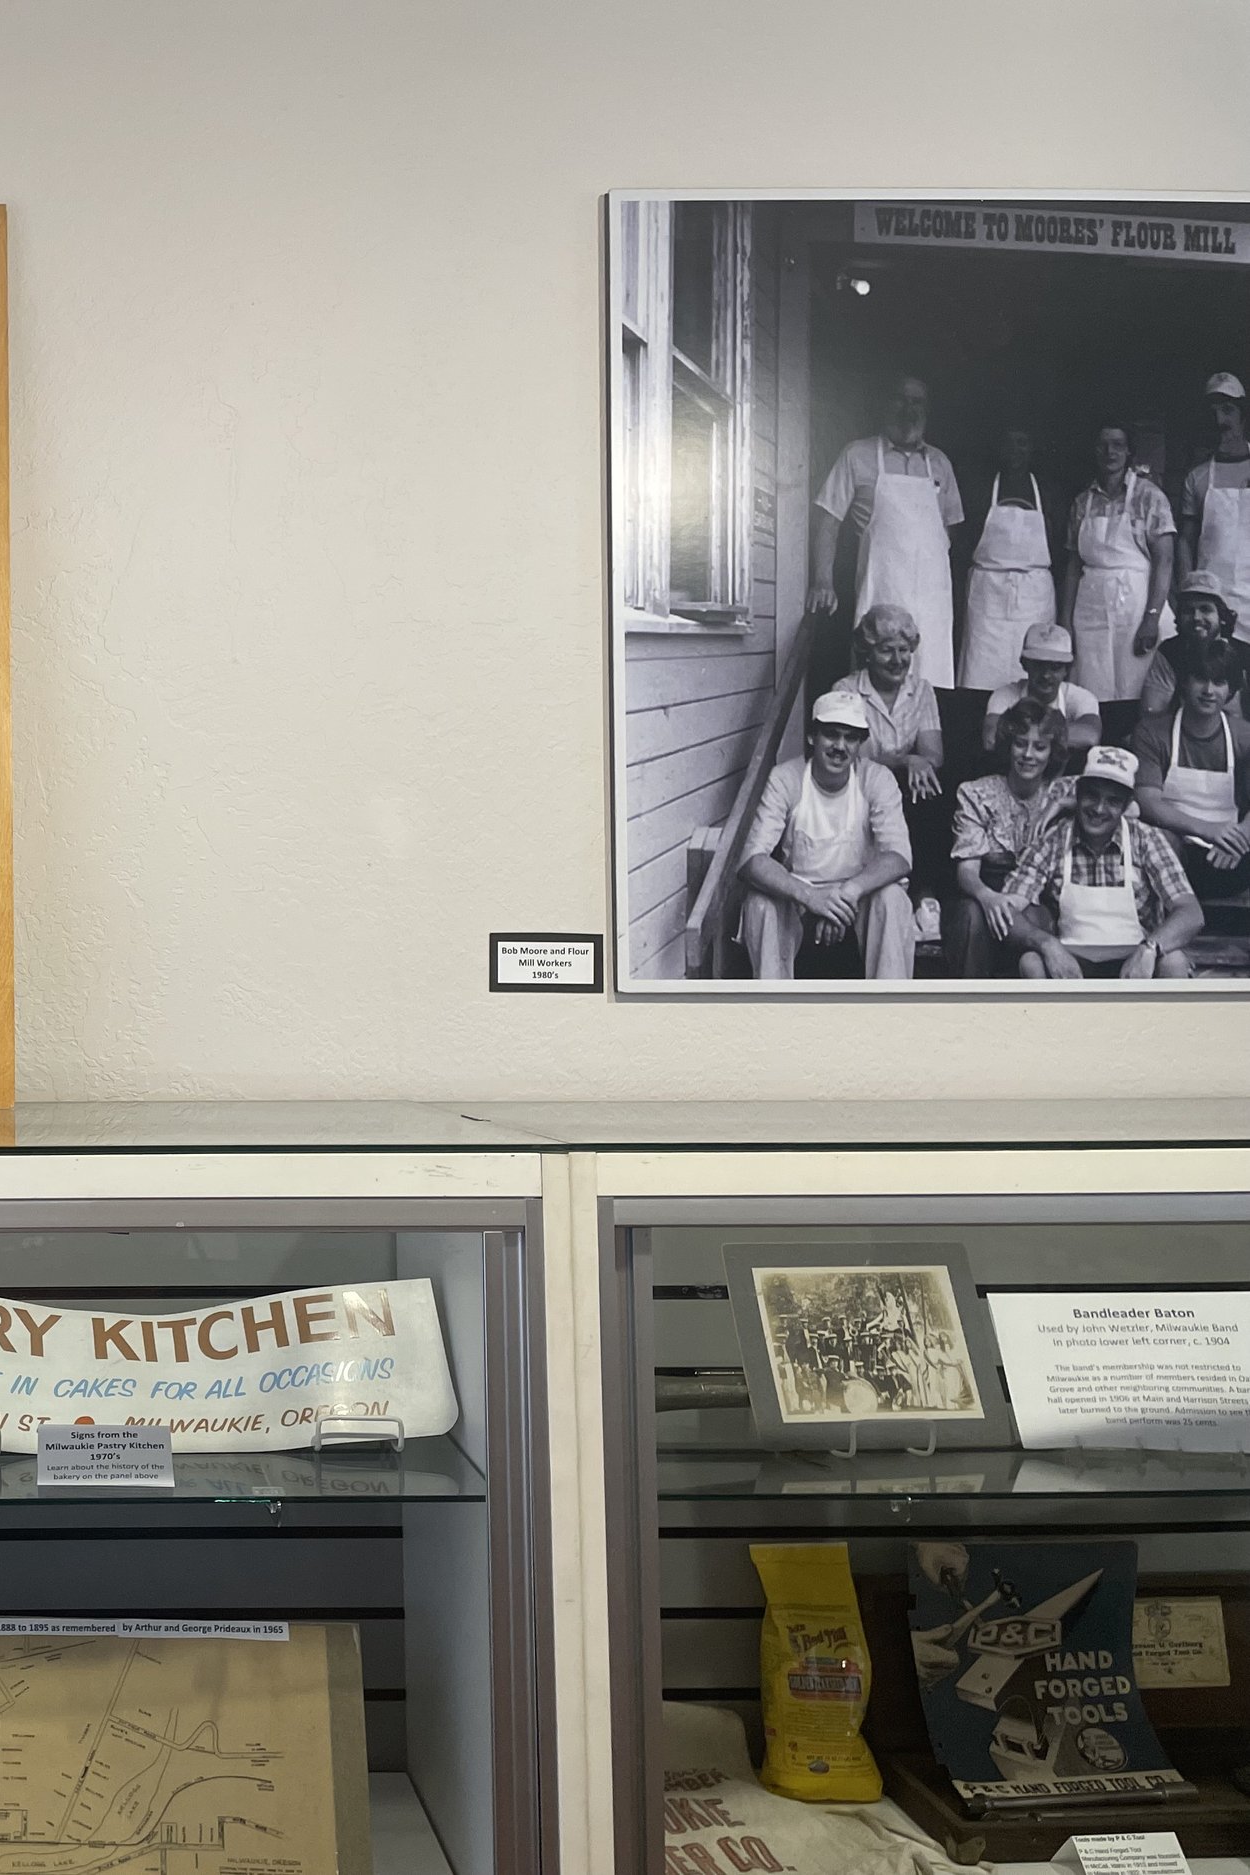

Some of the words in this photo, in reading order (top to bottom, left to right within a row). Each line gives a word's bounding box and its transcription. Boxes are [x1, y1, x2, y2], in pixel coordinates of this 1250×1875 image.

[875, 207, 976, 239] WELCOME
[982, 212, 1008, 241] TO
[1014, 214, 1104, 246] MOORES’
[1111, 219, 1176, 250] FLOUR
[1184, 224, 1236, 254] MILL
[501, 946, 518, 954] Bob
[520, 947, 548, 955] Moore
[549, 947, 565, 955] and
[567, 947, 589, 955] Flour
[518, 958, 534, 966] Mill
[536, 959, 572, 967] Workers
[1072, 1307, 1149, 1318] Bandleader
[1154, 1308, 1194, 1318] Baton
[91, 1288, 396, 1363] KITCHEN
[1037, 1324, 1064, 1333] Used
[1065, 1324, 1079, 1335] by
[1082, 1323, 1106, 1333] John
[1107, 1323, 1153, 1333] Wetzler,
[1155, 1322, 1209, 1332] Milwaukie
[1211, 1323, 1238, 1332] Band
[10, 1374, 39, 1396] IN
[53, 1377, 137, 1399] CAKES
[150, 1380, 198, 1401] FOR
[205, 1376, 247, 1399] ALL
[259, 1357, 395, 1393] OCCASIONS
[70, 1431, 95, 1440] Signs
[45, 1442, 94, 1450] Milwaukie
[97, 1442, 126, 1450] Pastry
[129, 1441, 164, 1449] Kitchen
[90, 1452, 120, 1460] 1970’s
[18, 1622, 27, 1632] to
[29, 1623, 49, 1633] 1895
[50, 1625, 61, 1633] as
[62, 1623, 116, 1633] remembered
[122, 1622, 133, 1632] by
[134, 1623, 162, 1631] Arthur
[164, 1623, 179, 1632] and
[181, 1623, 212, 1634] George
[213, 1624, 251, 1633] Prideaux
[252, 1625, 260, 1633] in
[263, 1625, 283, 1633] 1965
[1043, 1650, 1113, 1672] HAND
[1034, 1676, 1131, 1700] FORGED
[1046, 1702, 1128, 1726] TOOLS
